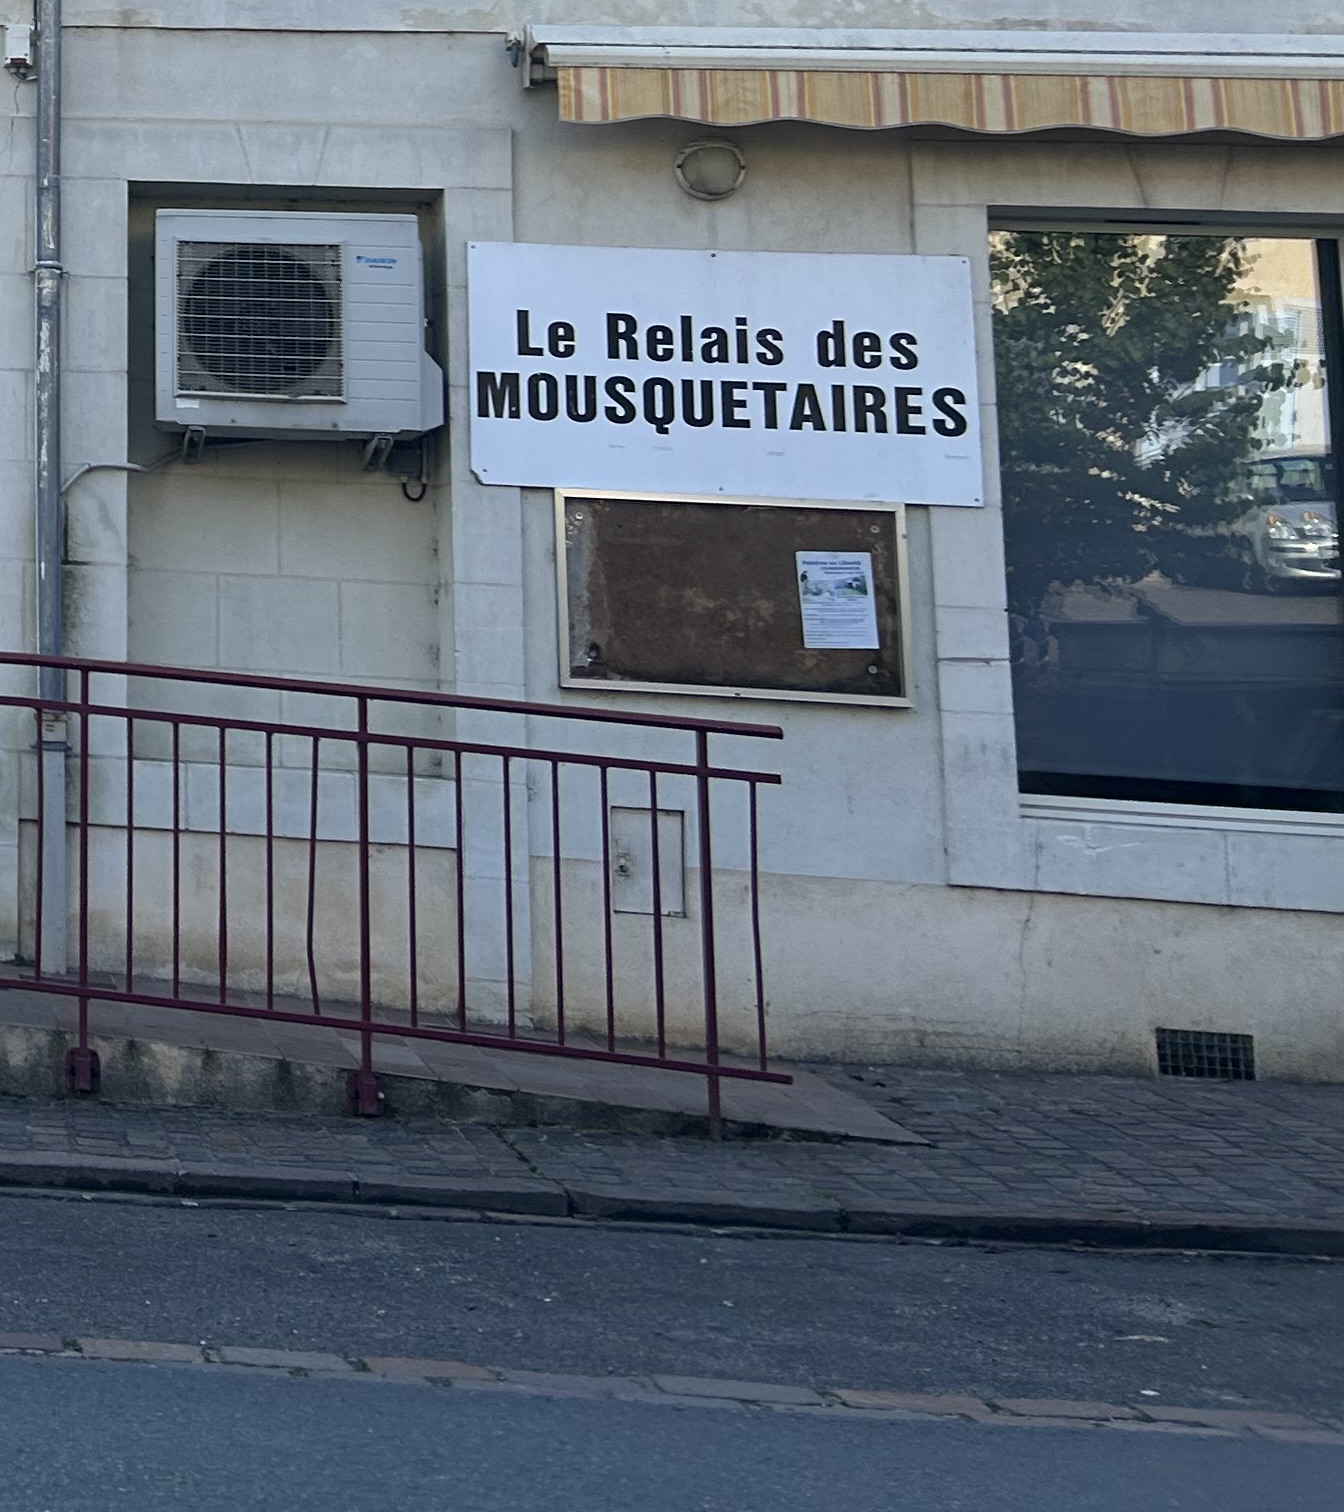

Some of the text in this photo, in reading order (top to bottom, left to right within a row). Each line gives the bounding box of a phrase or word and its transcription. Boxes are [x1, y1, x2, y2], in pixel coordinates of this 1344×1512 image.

[516, 308, 918, 370] Le Relais des
[476, 371, 968, 437] MOUSQUETAIRES
